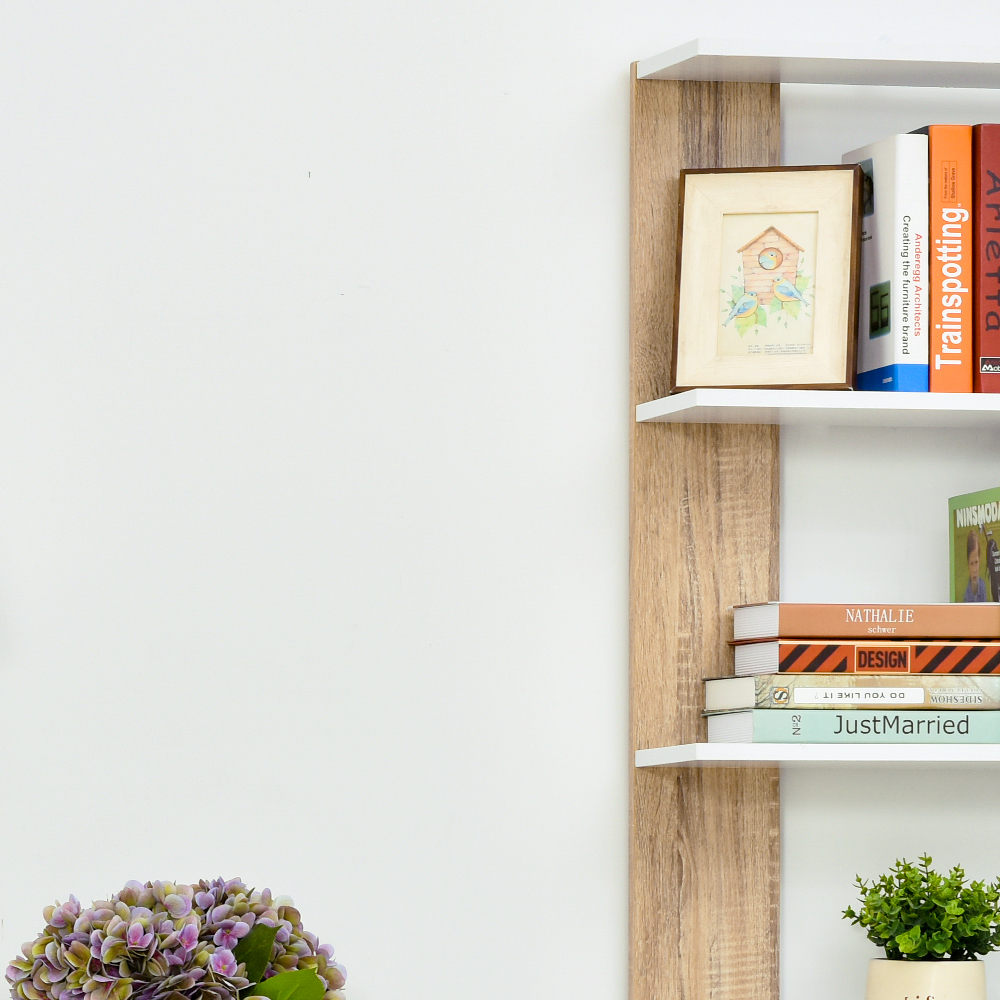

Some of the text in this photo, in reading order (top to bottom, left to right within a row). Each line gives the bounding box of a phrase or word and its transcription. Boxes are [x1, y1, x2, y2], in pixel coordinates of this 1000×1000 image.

[900, 215, 911, 354] Creating the furniture brand
[913, 233, 923, 337] Anderegg Architects
[935, 208, 969, 370] Trainspotting
[846, 609, 914, 623] NATHALIE
[868, 626, 896, 634] schwer
[858, 650, 907, 668] DESIGN
[834, 715, 969, 735] JustMarried
